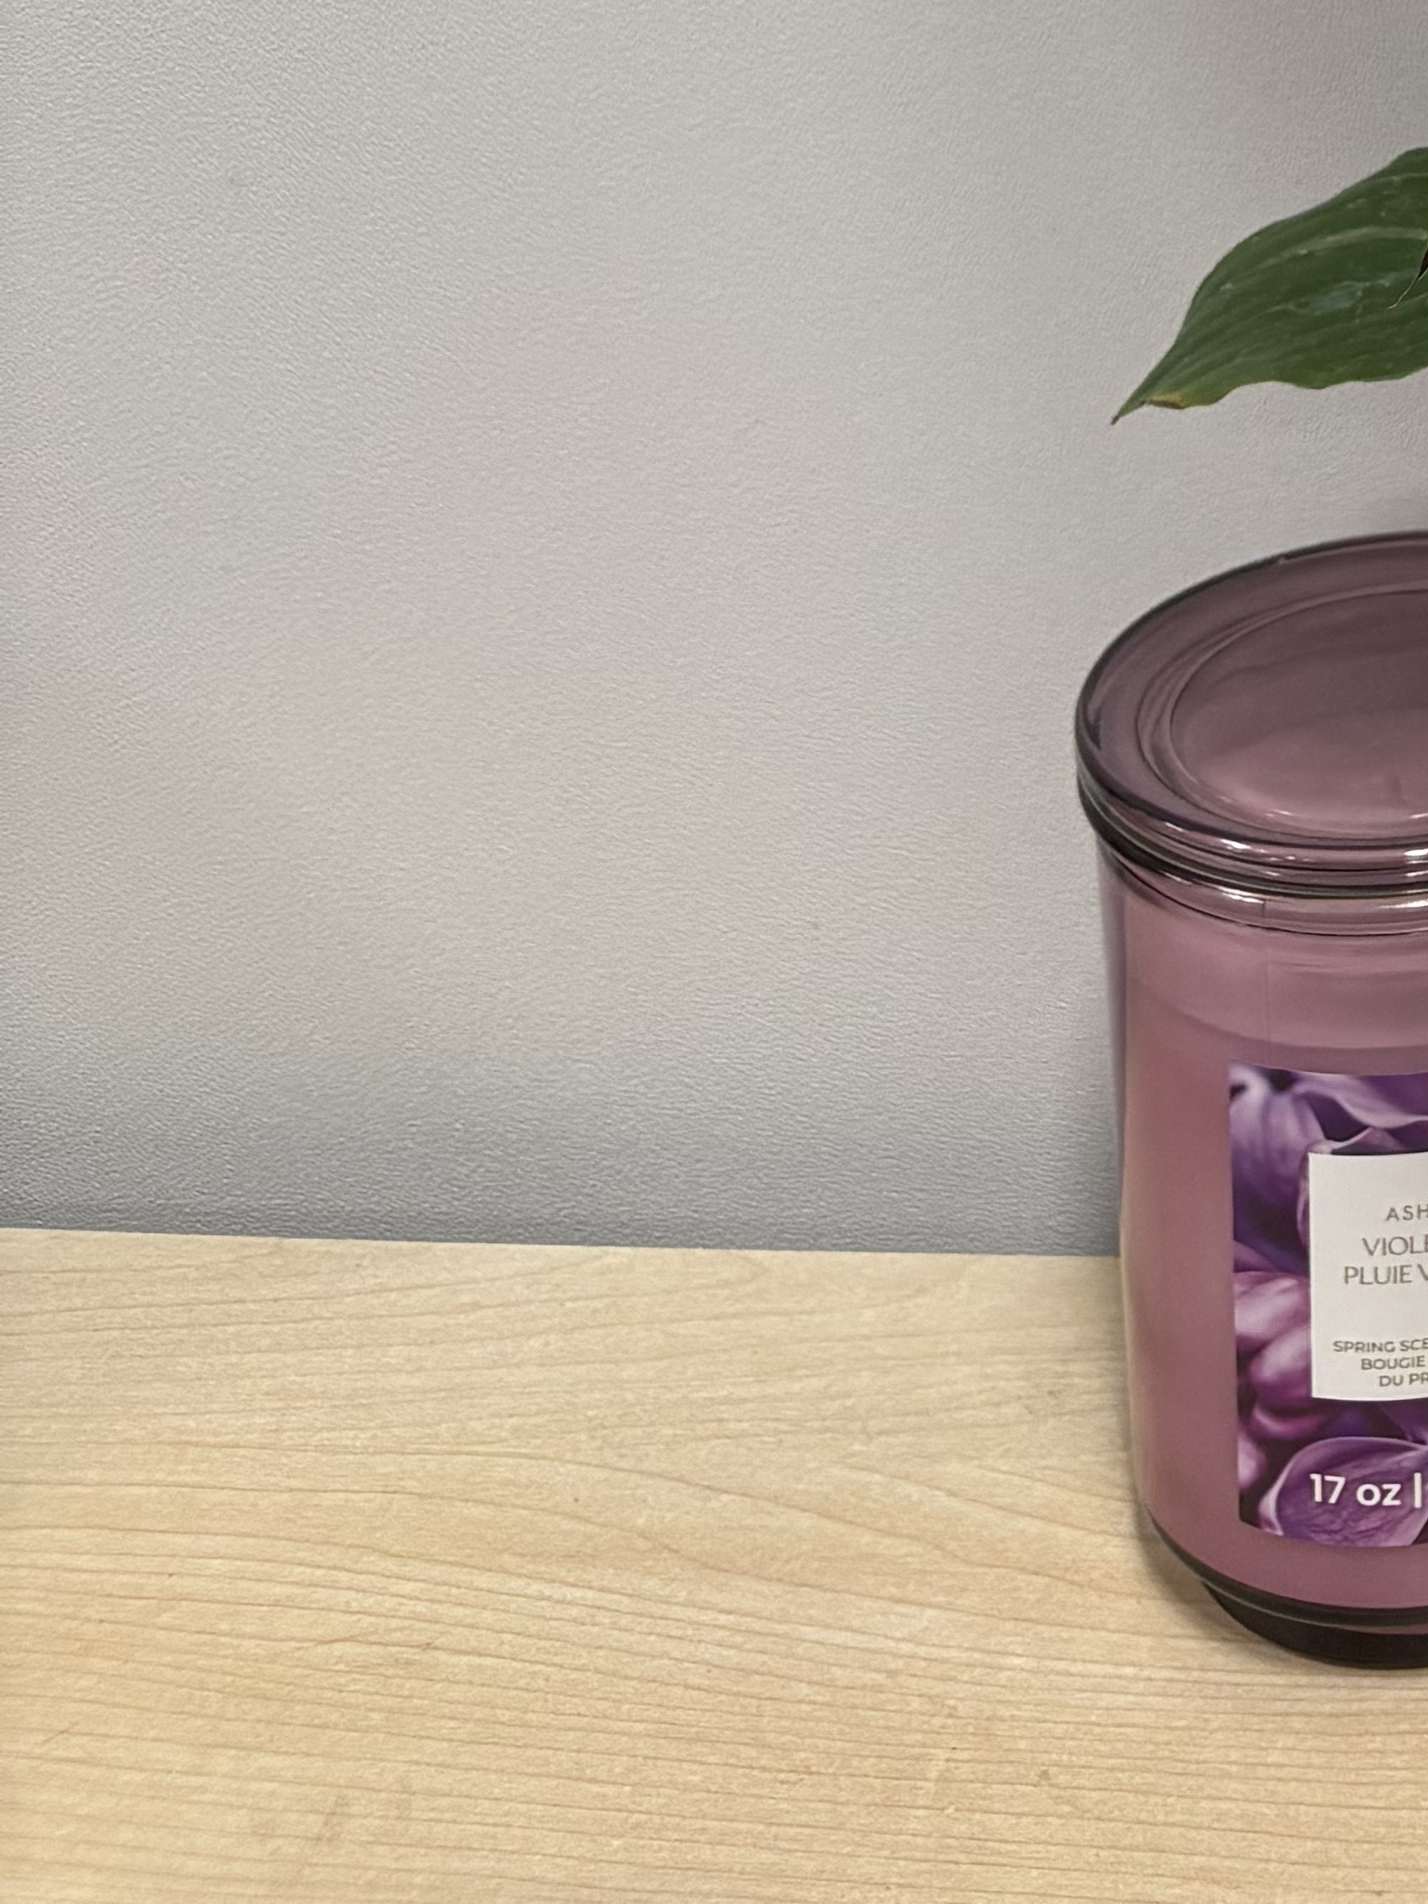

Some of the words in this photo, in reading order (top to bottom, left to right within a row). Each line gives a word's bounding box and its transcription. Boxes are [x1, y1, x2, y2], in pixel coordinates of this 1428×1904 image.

[1344, 1264, 1413, 1286] PLUIE
[1332, 1340, 1396, 1353] SPRING
[1360, 1355, 1426, 1371] BOUGIE
[1379, 1374, 1404, 1388] DU
[1309, 1473, 1345, 1505] 17
[1356, 1480, 1402, 1508] oz
